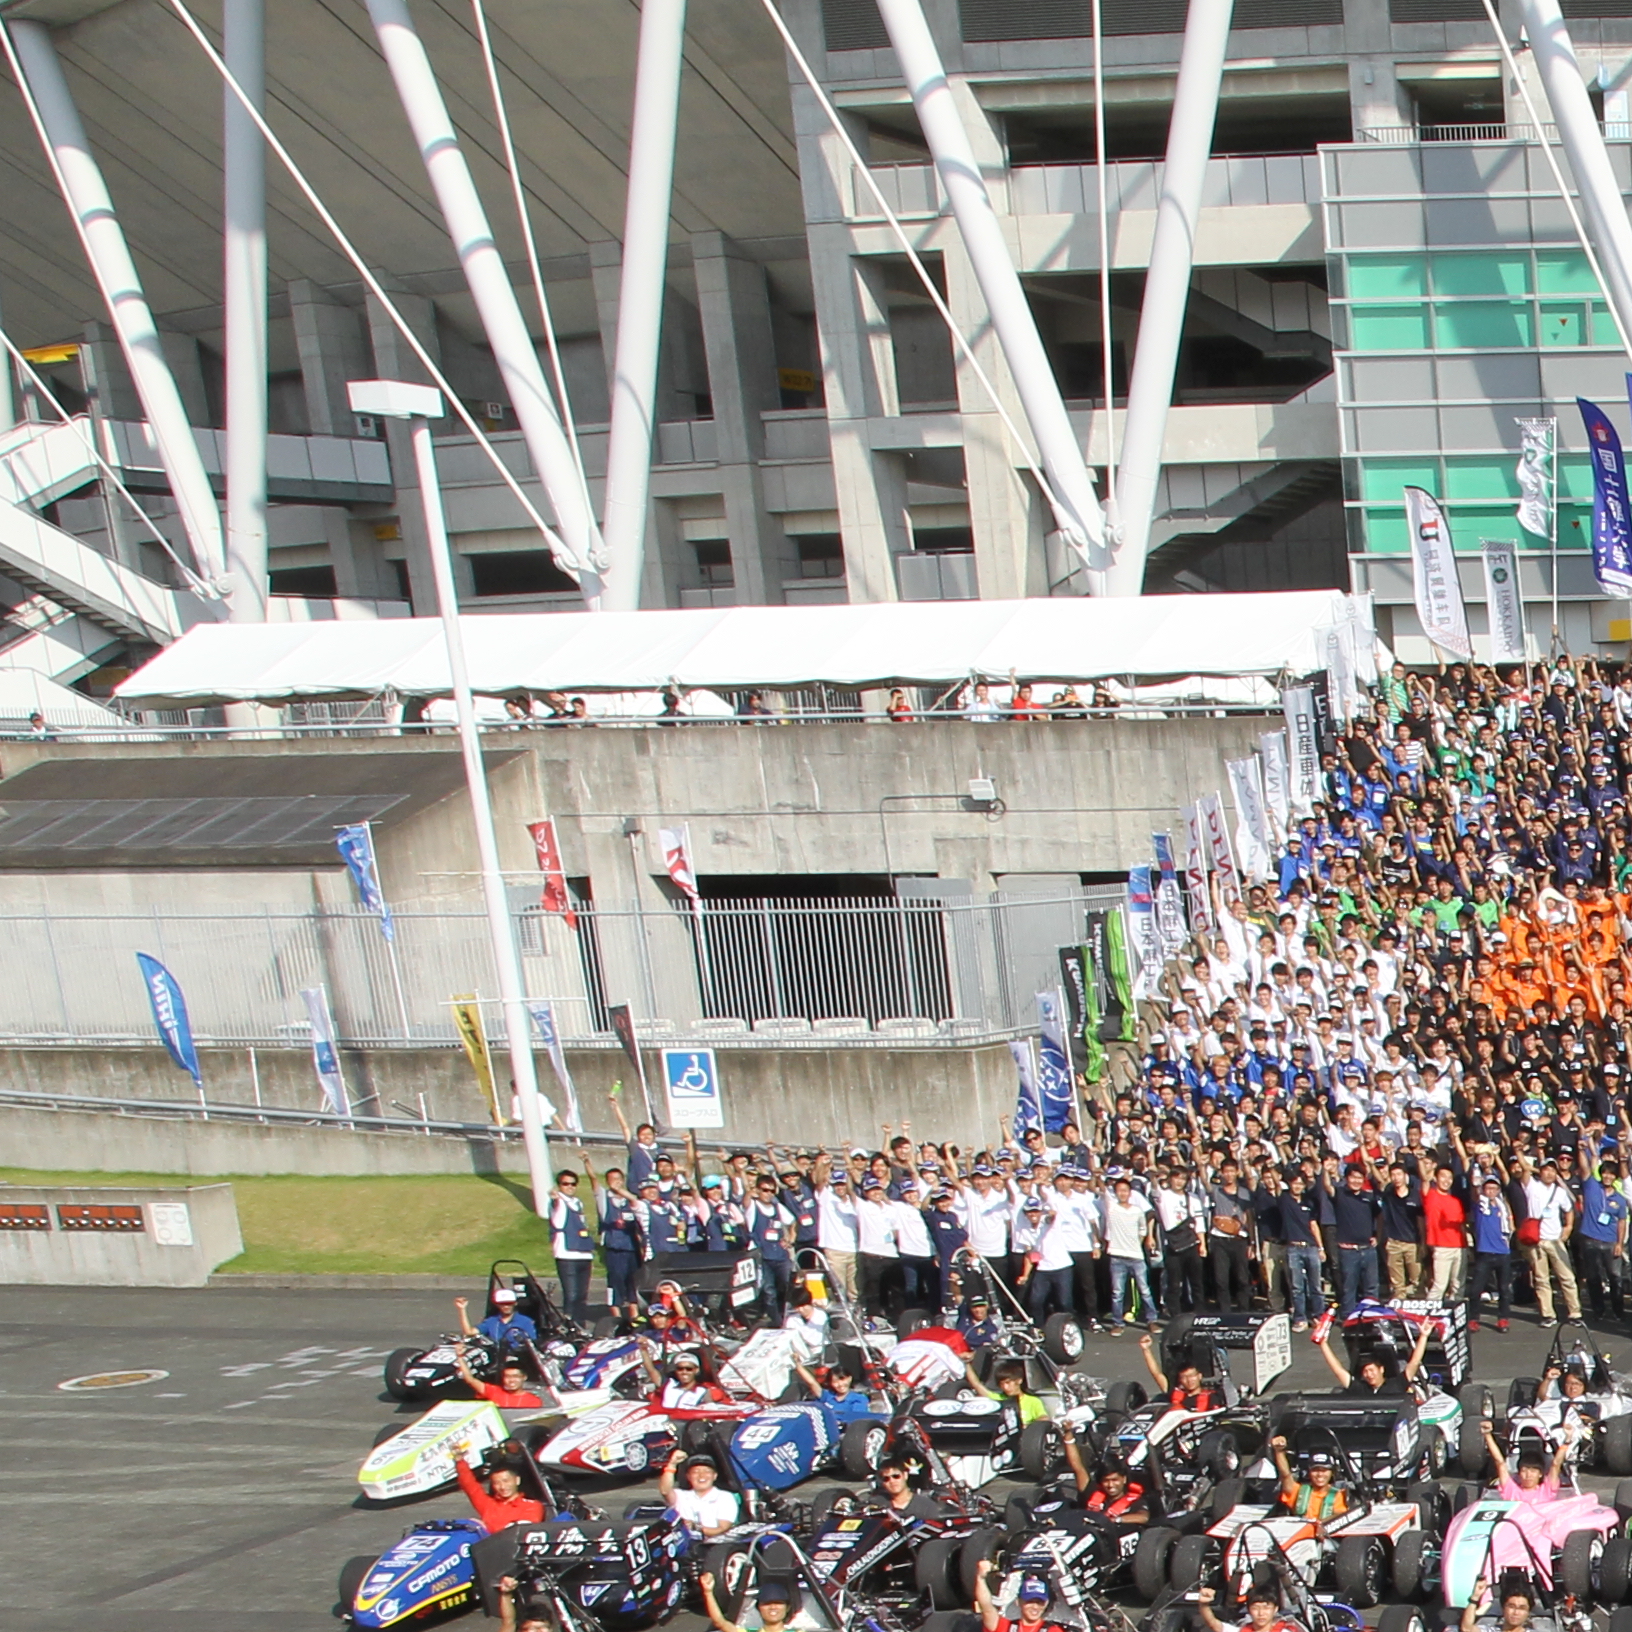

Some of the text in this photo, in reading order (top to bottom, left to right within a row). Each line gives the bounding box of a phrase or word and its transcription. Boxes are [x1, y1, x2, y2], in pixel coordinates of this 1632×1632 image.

[740, 1261, 753, 1280] 12
[1402, 1299, 1444, 1310] BOSCH
[745, 1428, 775, 1440] 44
[626, 1541, 648, 1569] 13
